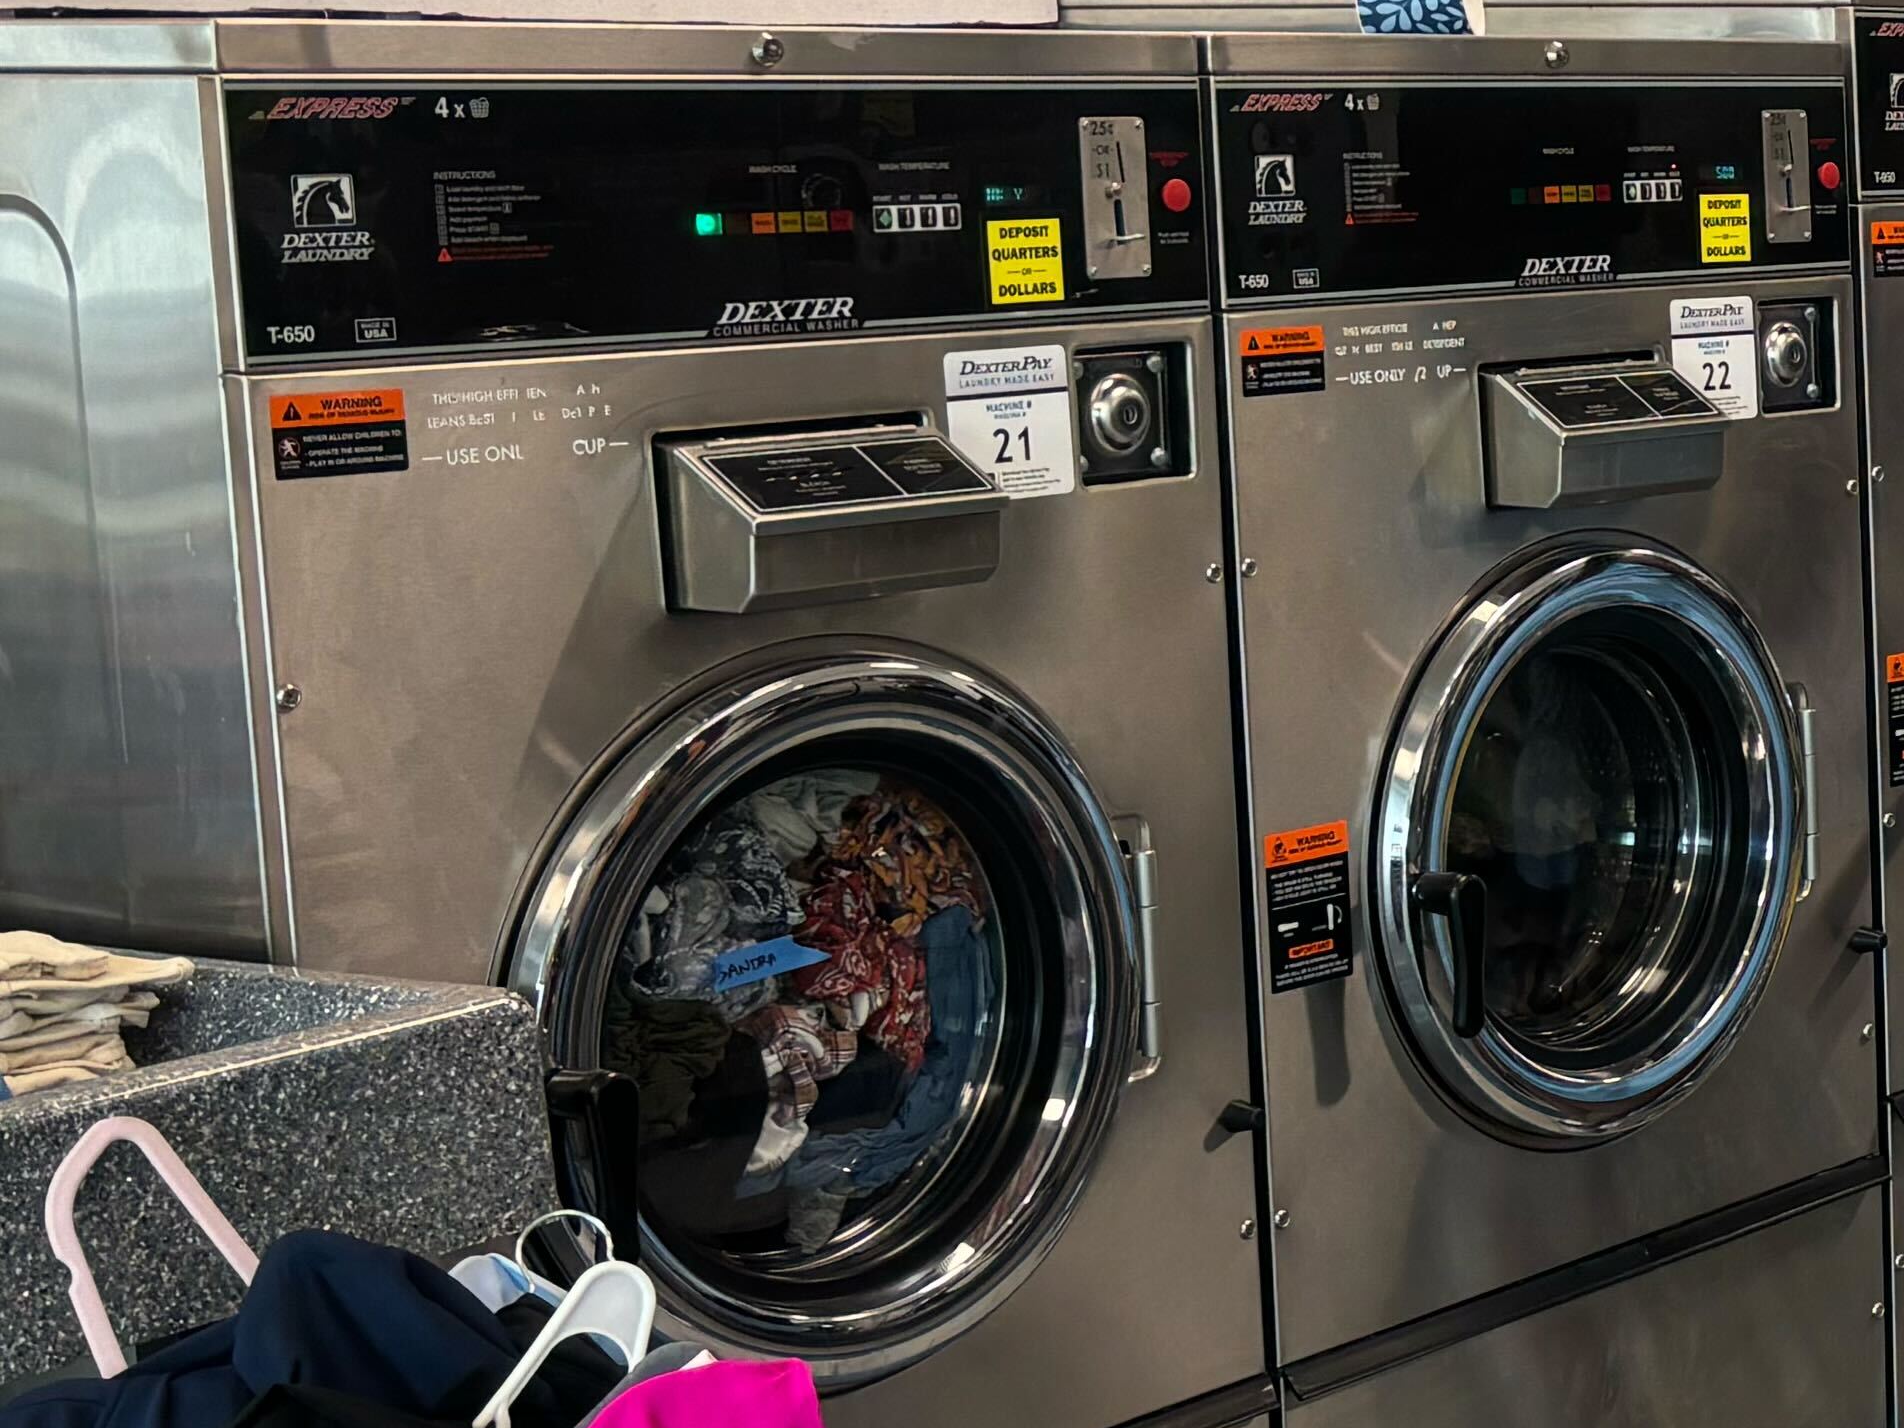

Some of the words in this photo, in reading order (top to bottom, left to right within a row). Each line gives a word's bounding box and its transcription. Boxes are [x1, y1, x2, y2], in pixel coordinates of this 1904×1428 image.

[267, 97, 398, 120] EXPRESS
[435, 97, 449, 118] 4
[454, 103, 465, 118] x
[1240, 94, 1323, 112] EXPRESS
[1344, 93, 1354, 110] 4
[1356, 100, 1364, 110] x
[1248, 200, 1306, 213] DEXTER
[1706, 200, 1742, 210] DEPOSIT
[1248, 213, 1307, 225] LAUNDRY
[1702, 215, 1748, 229] QUARTERS
[999, 225, 1049, 239] DEPOSIT
[281, 232, 373, 249] DEXTER
[281, 247, 375, 263] LAUNDRY
[992, 246, 1059, 262] QUARTERS
[1706, 246, 1746, 257] DOLLARS
[1520, 255, 1611, 277] DEXTER
[1238, 274, 1269, 289] T-650
[1518, 276, 1575, 287] COMMERCIAL
[1578, 273, 1614, 284] WASHER
[999, 282, 1057, 297] DOLLARS
[717, 297, 854, 325] DEXTER
[267, 326, 315, 344] T-650
[364, 330, 388, 338] USA
[713, 323, 800, 338] COMMERCIAL
[806, 319, 859, 332] WASHER
[959, 375, 1001, 389] LAUNDRY
[1004, 374, 1029, 385] MADE
[1032, 373, 1055, 383] EASY
[1350, 370, 1373, 385] USE
[1702, 361, 1732, 391] 22
[321, 396, 383, 410] WARNING
[302, 434, 328, 442] NEVER
[328, 432, 353, 441] ALLOW
[354, 430, 390, 439] CHILDREN
[354, 445, 383, 453] MACHINE
[446, 447, 480, 466] USE
[483, 444, 525, 462] ONL
[572, 437, 607, 455] CUP
[992, 426, 1031, 464] 21
[1296, 831, 1336, 846] WARNING
